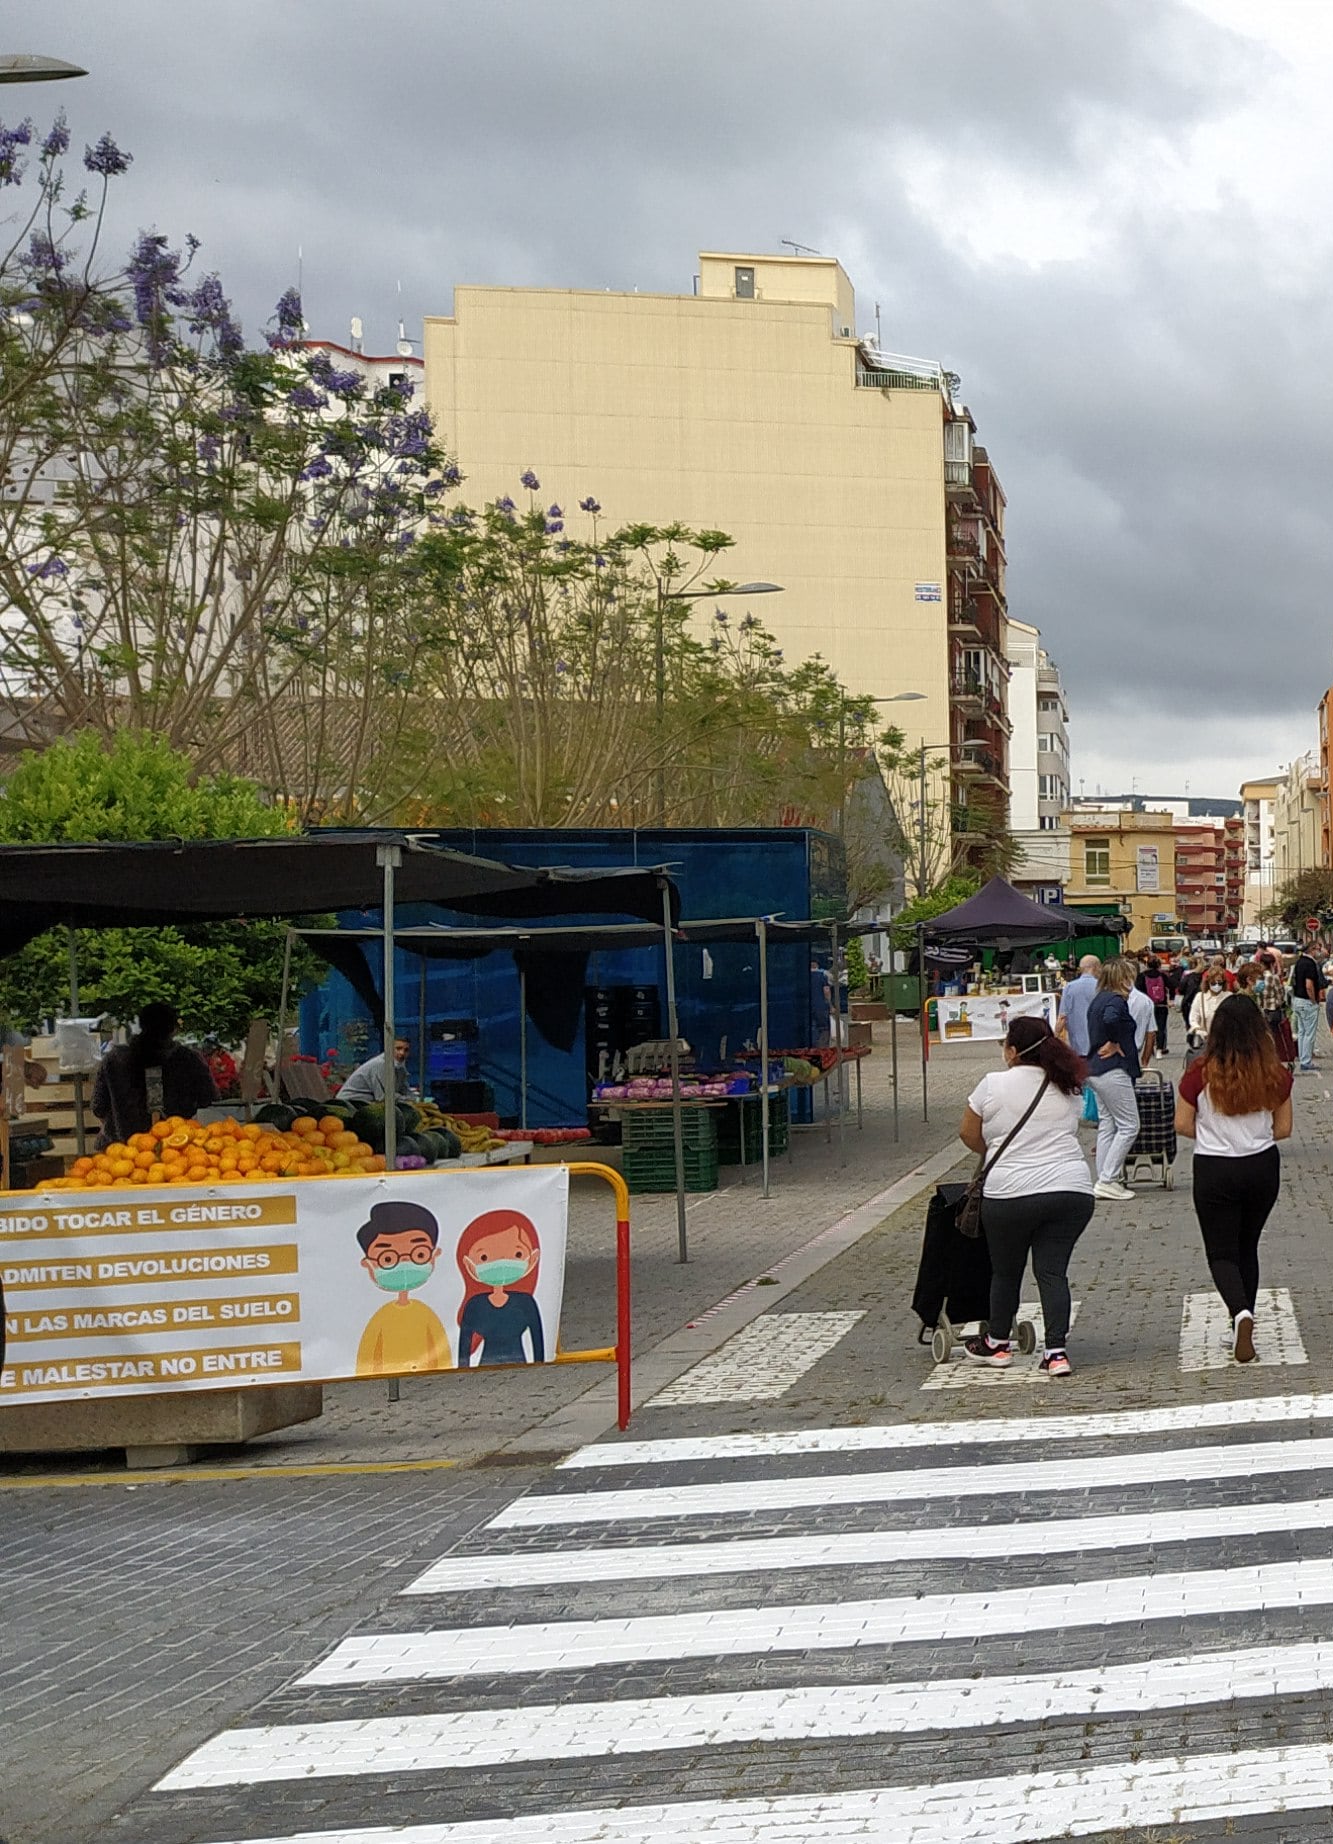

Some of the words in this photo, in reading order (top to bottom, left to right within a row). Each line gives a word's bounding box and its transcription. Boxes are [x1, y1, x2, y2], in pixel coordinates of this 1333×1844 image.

[1044, 888, 1058, 903] P
[53, 1210, 132, 1231] TOCAR
[137, 1209, 165, 1226] EL
[170, 1204, 262, 1223] GÉNERO
[99, 1253, 271, 1279] DEVOLUCIONES
[24, 1312, 68, 1334] LAS
[74, 1308, 167, 1330] MARCAS
[173, 1305, 215, 1323] DEL
[220, 1299, 292, 1320] SUELO
[22, 1360, 154, 1386] MALESTAR
[160, 1357, 196, 1376] NO
[202, 1350, 283, 1372] ENTRE
